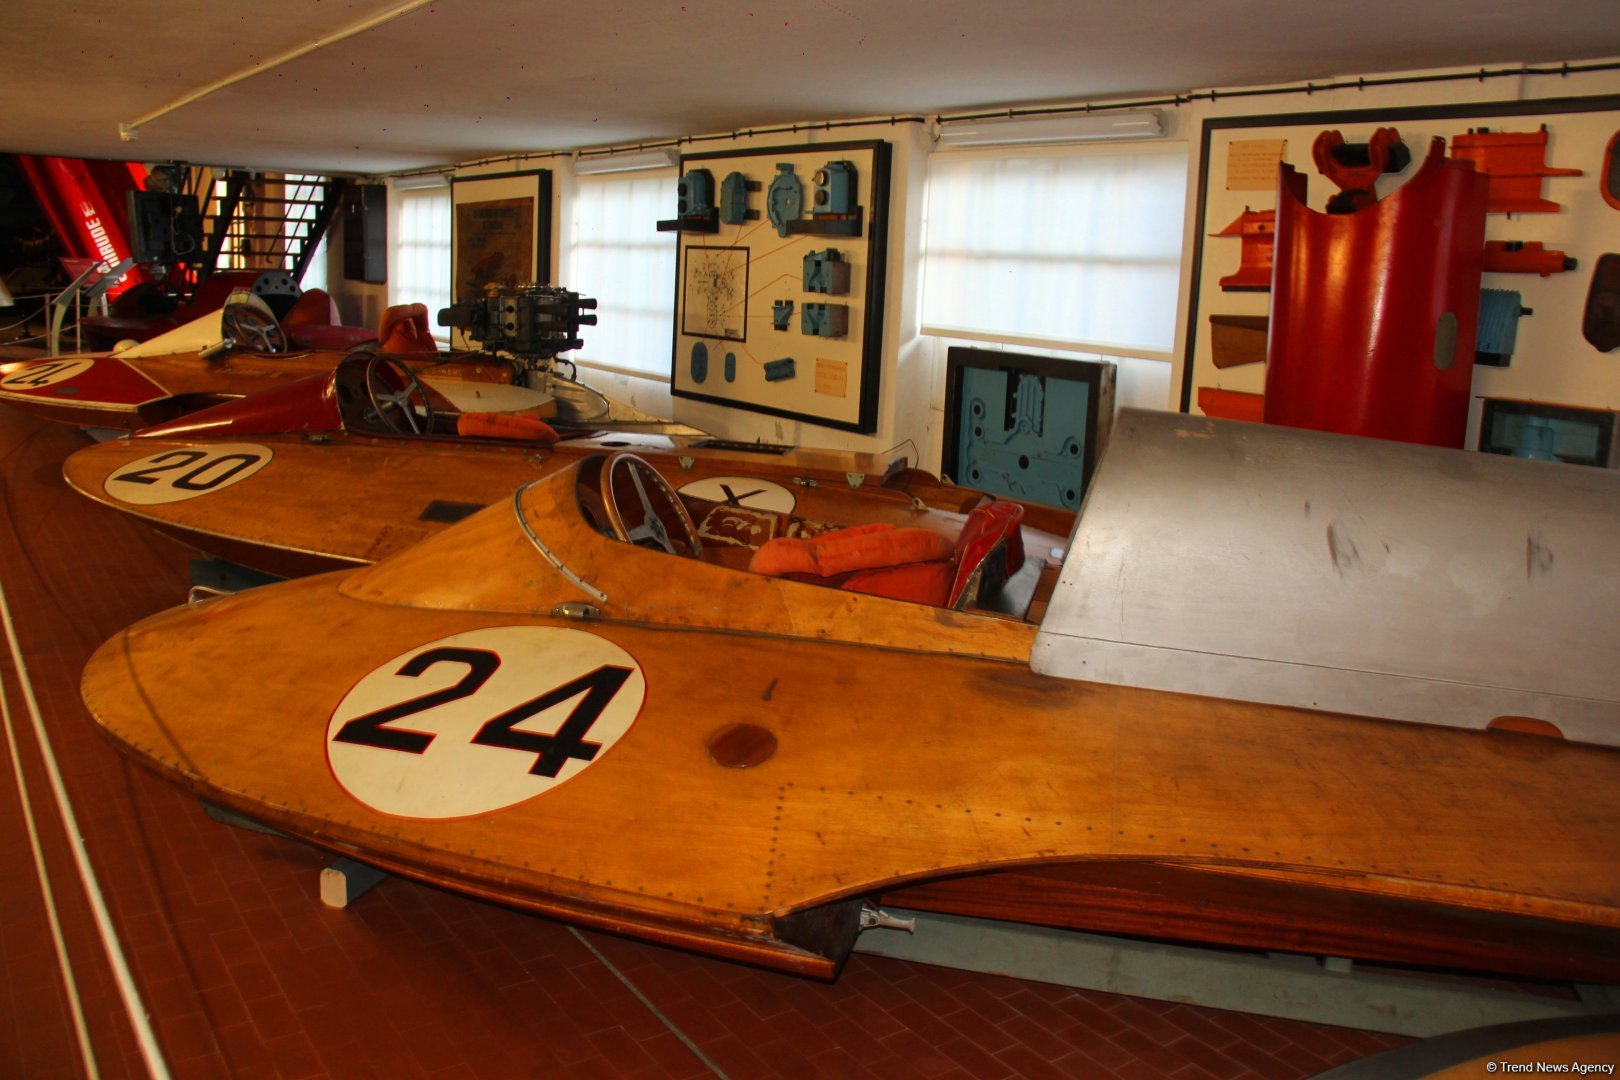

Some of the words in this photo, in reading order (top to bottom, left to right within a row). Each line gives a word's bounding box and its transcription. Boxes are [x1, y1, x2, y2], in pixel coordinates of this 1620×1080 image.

[3, 361, 83, 387] 24
[112, 450, 262, 491] 20
[331, 645, 636, 779] 24
